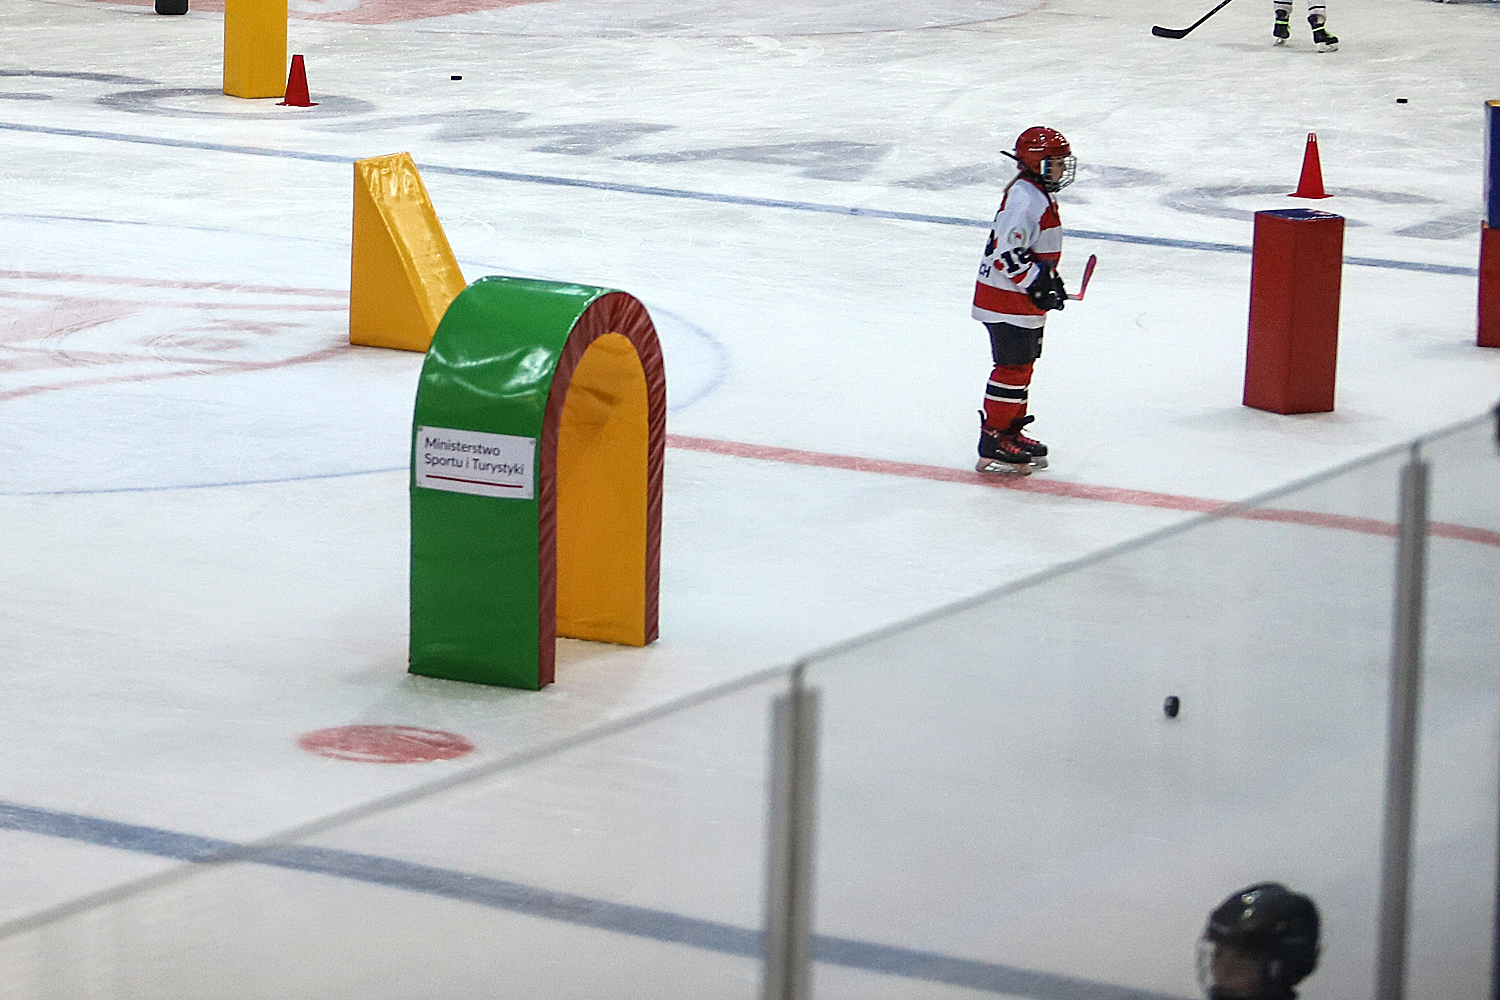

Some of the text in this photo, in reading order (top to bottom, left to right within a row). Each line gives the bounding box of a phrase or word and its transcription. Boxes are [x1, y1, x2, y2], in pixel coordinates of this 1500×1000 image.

[424, 437, 501, 457] Ministerstwo
[424, 453, 463, 469] Sportu
[472, 458, 525, 477] Turystyki
